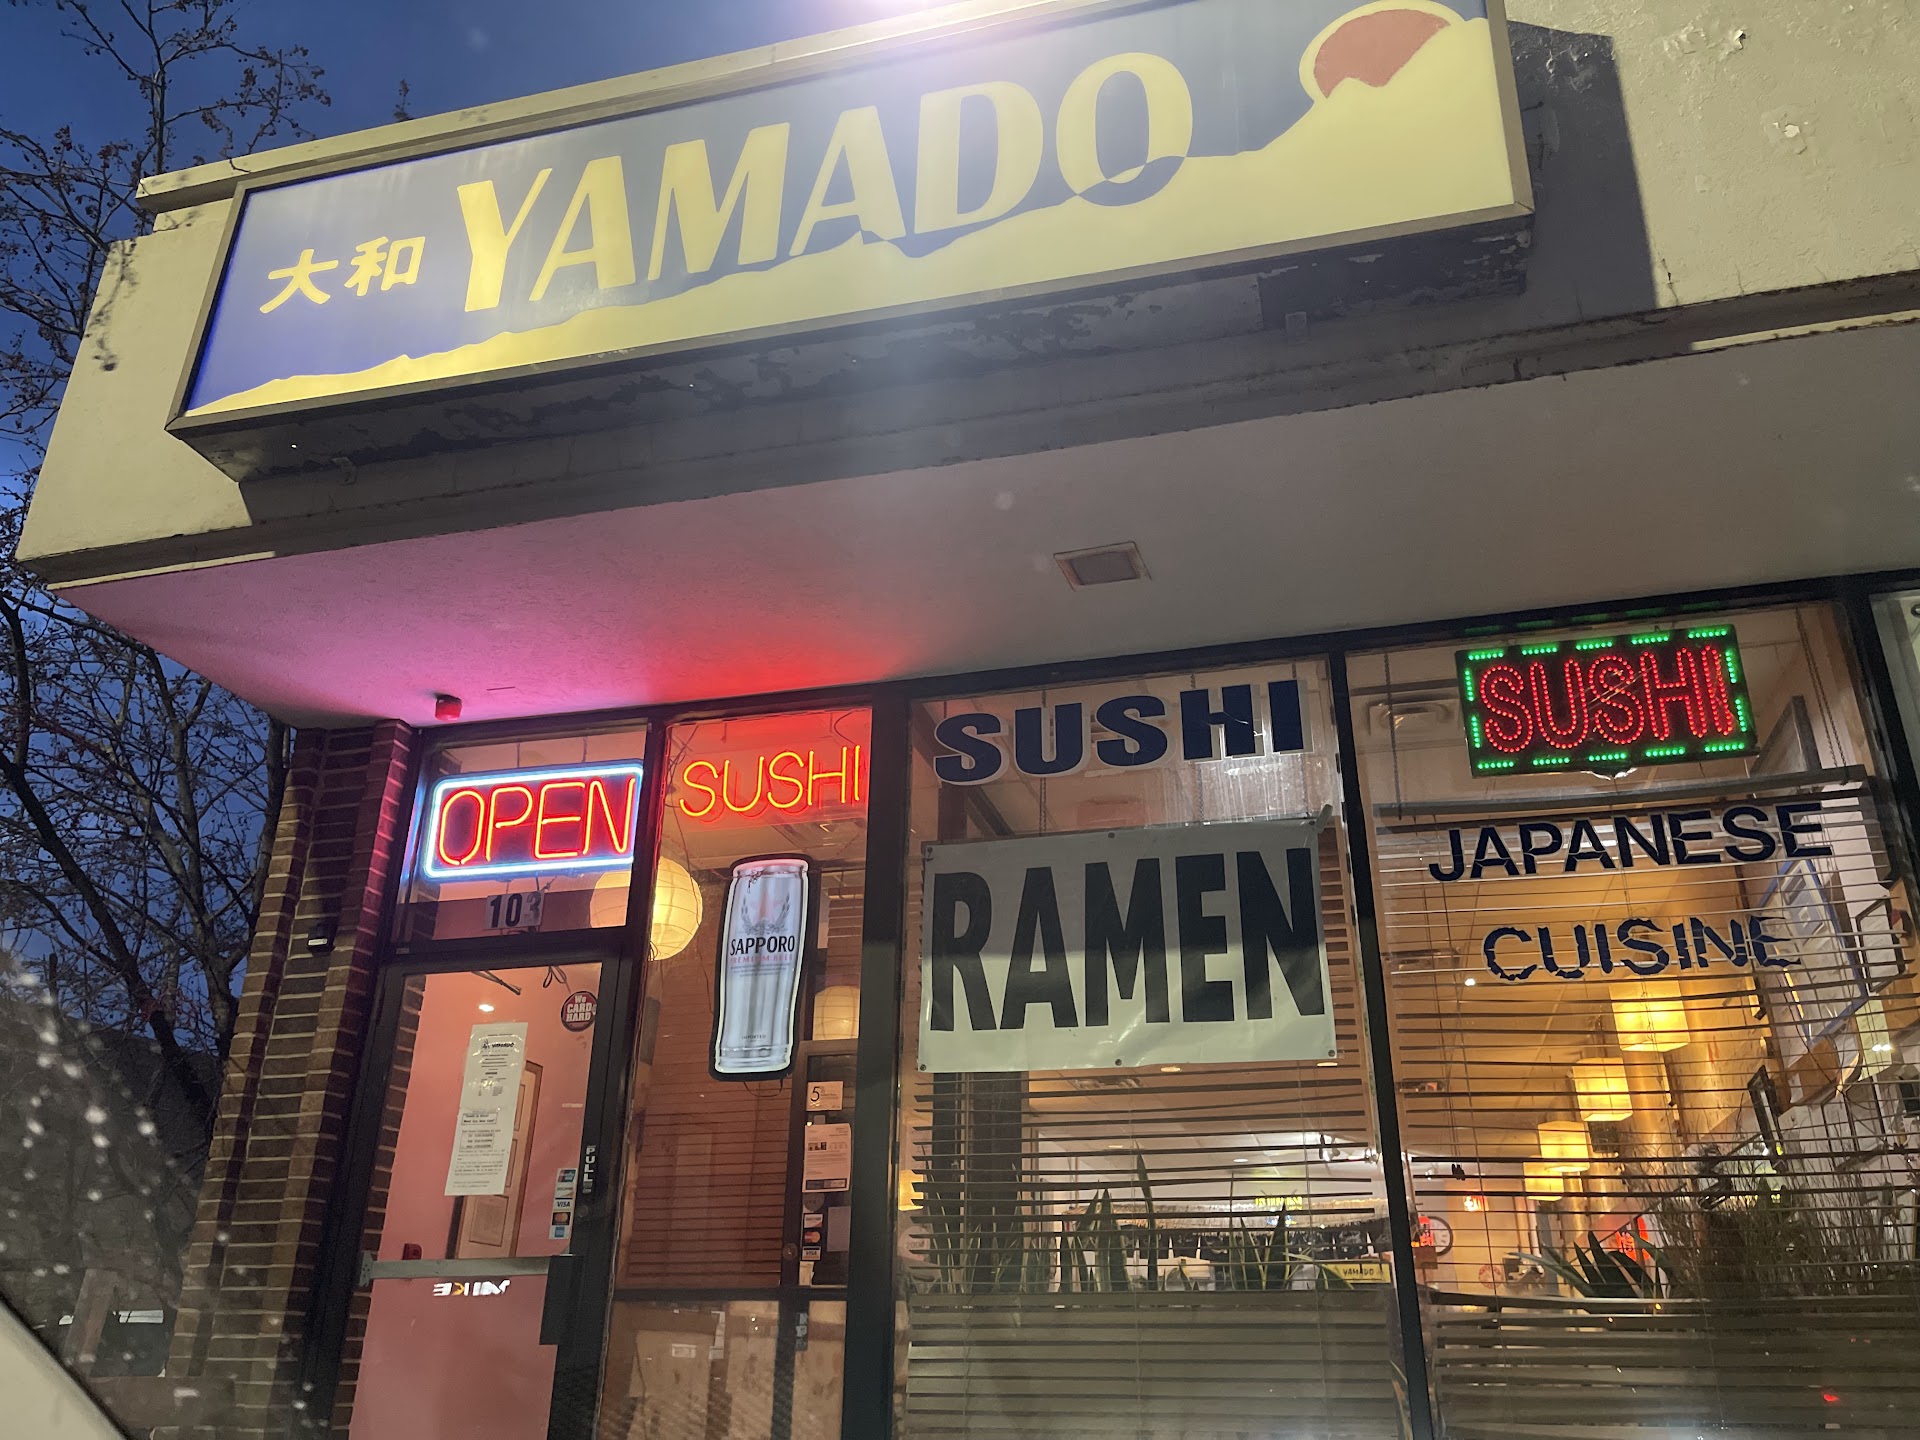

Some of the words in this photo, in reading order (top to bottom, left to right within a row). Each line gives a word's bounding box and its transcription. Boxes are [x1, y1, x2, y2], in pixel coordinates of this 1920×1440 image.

[457, 52, 1193, 312] YAMADO
[260, 236, 425, 314] 大和
[932, 679, 1309, 785] SUSHI
[1479, 644, 1735, 754] SUSHI
[679, 745, 861, 816] SUSHI
[438, 777, 636, 866] OPEN
[1428, 802, 1834, 882] JAPANESE
[730, 935, 796, 956] SAPPORO
[929, 847, 1326, 1032] RAMEN
[1483, 916, 1801, 981] CUISINE
[566, 1012, 591, 1022] HARD
[567, 1002, 592, 1013] CARD
[575, 995, 586, 1003] We
[810, 1086, 820, 1102] 5
[583, 1147, 596, 1182] PULL
